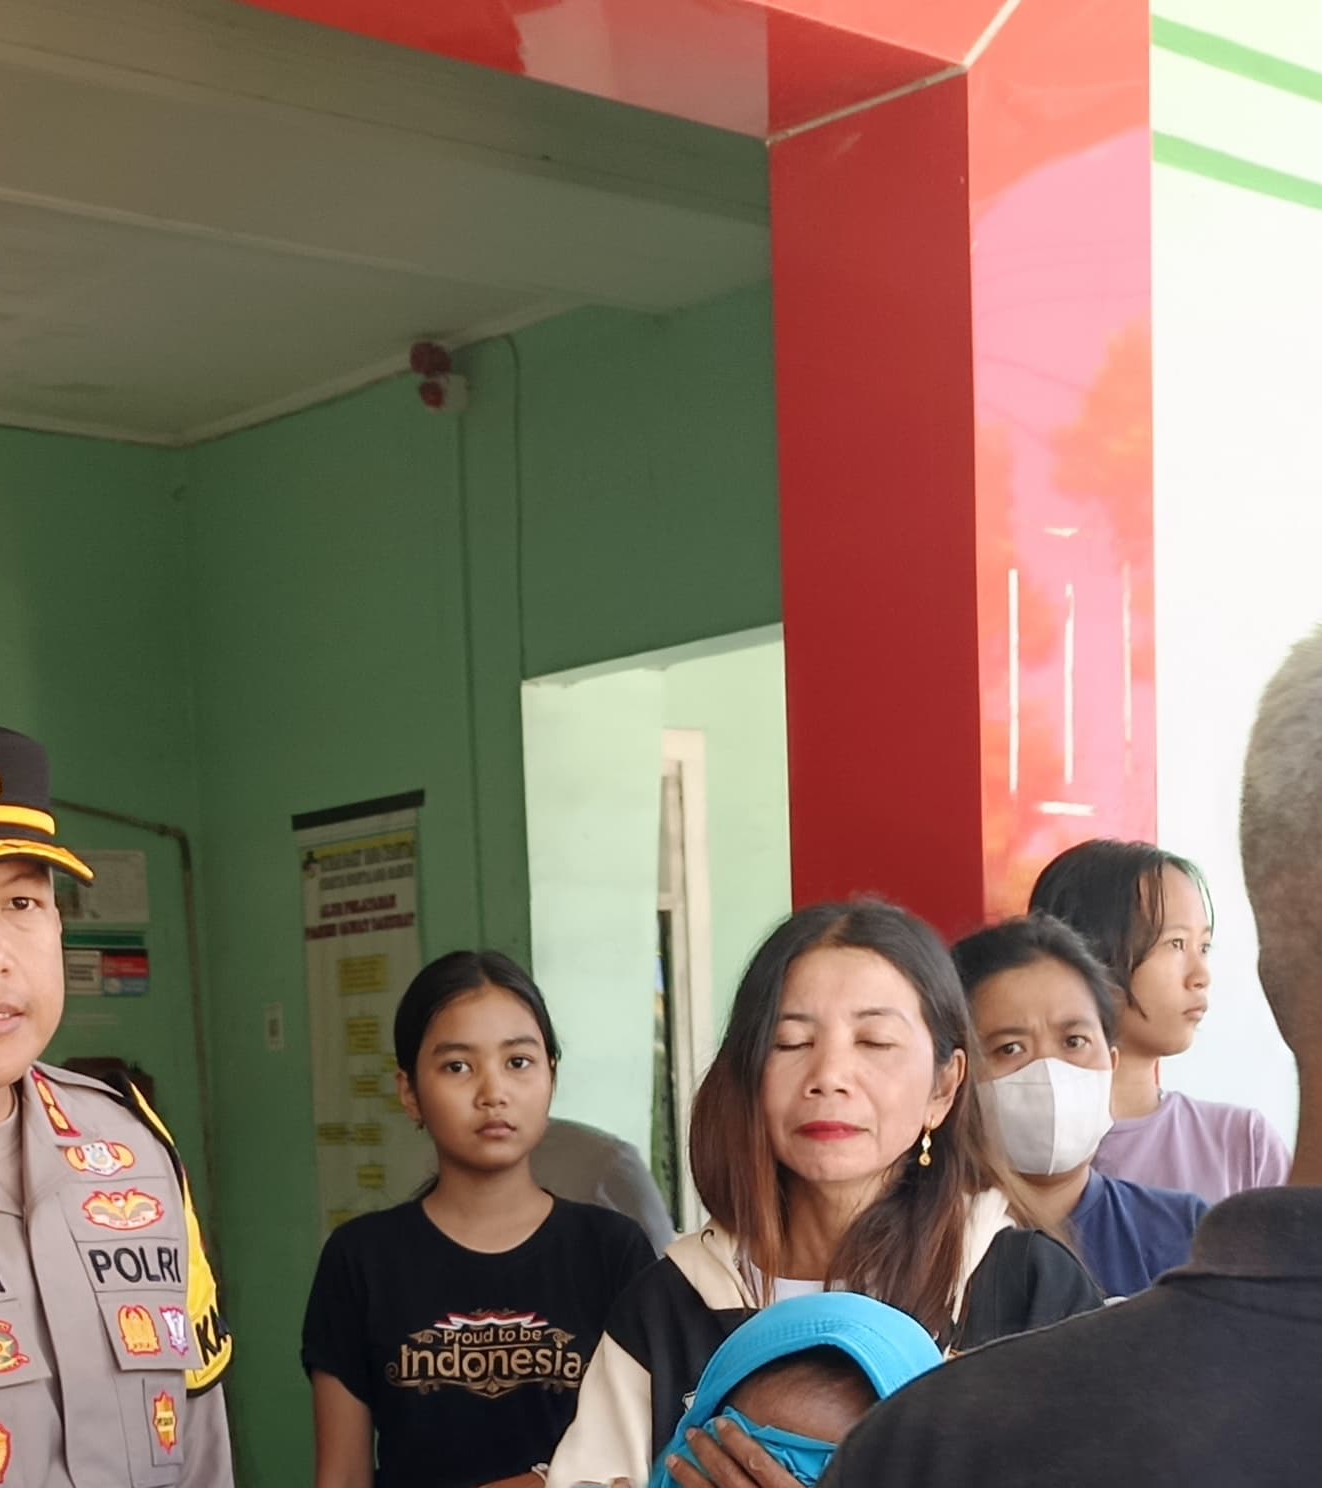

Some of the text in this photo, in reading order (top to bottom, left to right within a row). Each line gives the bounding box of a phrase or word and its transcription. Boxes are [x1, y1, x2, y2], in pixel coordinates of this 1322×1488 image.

[88, 1245, 182, 1284] POLRI
[443, 1327, 542, 1344] Proud to be
[400, 1343, 582, 1378] Indonesia
